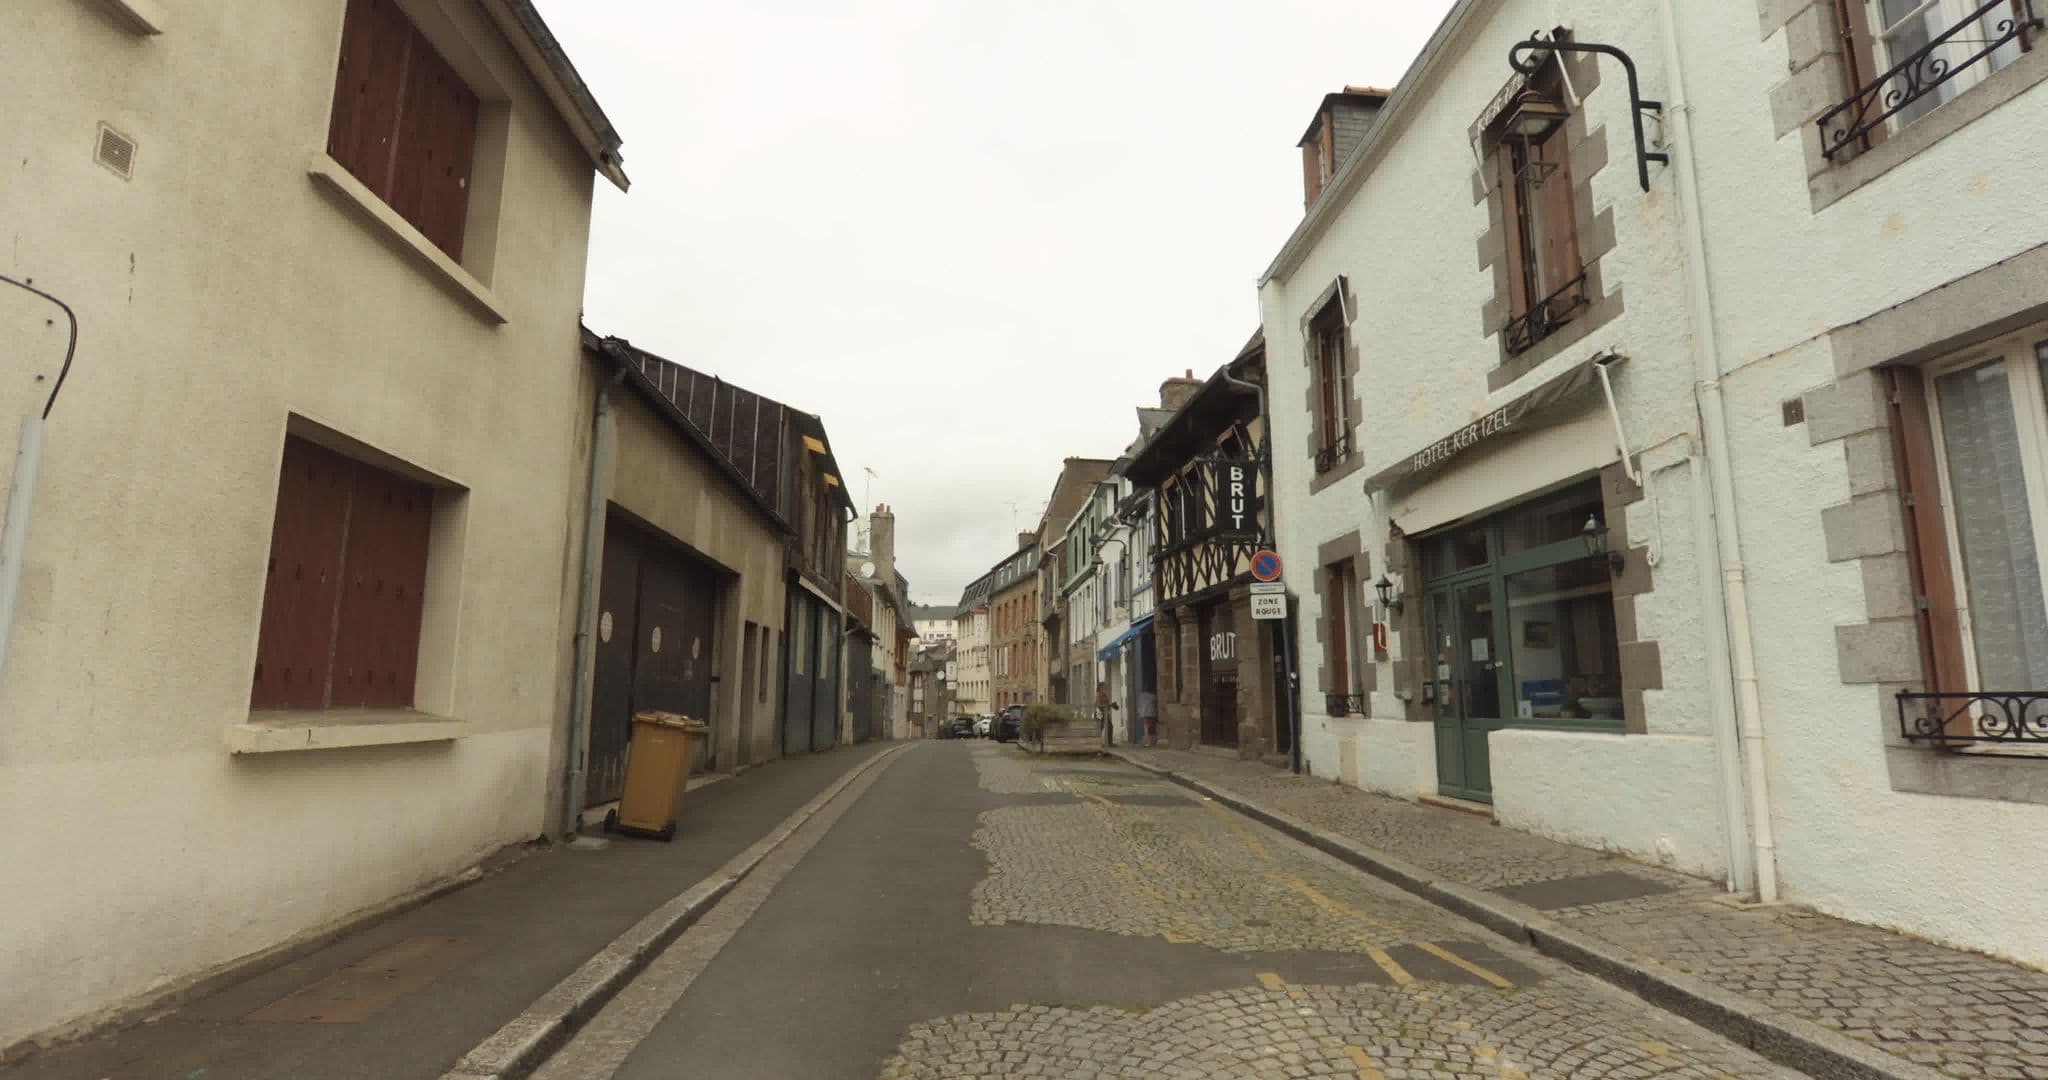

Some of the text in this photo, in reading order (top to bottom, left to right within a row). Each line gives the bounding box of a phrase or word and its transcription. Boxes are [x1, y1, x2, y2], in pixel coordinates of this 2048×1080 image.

[1413, 407, 1511, 471] HOTEL KER IZEL
[1230, 466, 1244, 530] BRUT
[1255, 607, 1281, 616] ROUGE
[1258, 597, 1278, 605] ZONE
[1210, 631, 1236, 661] BRUT
